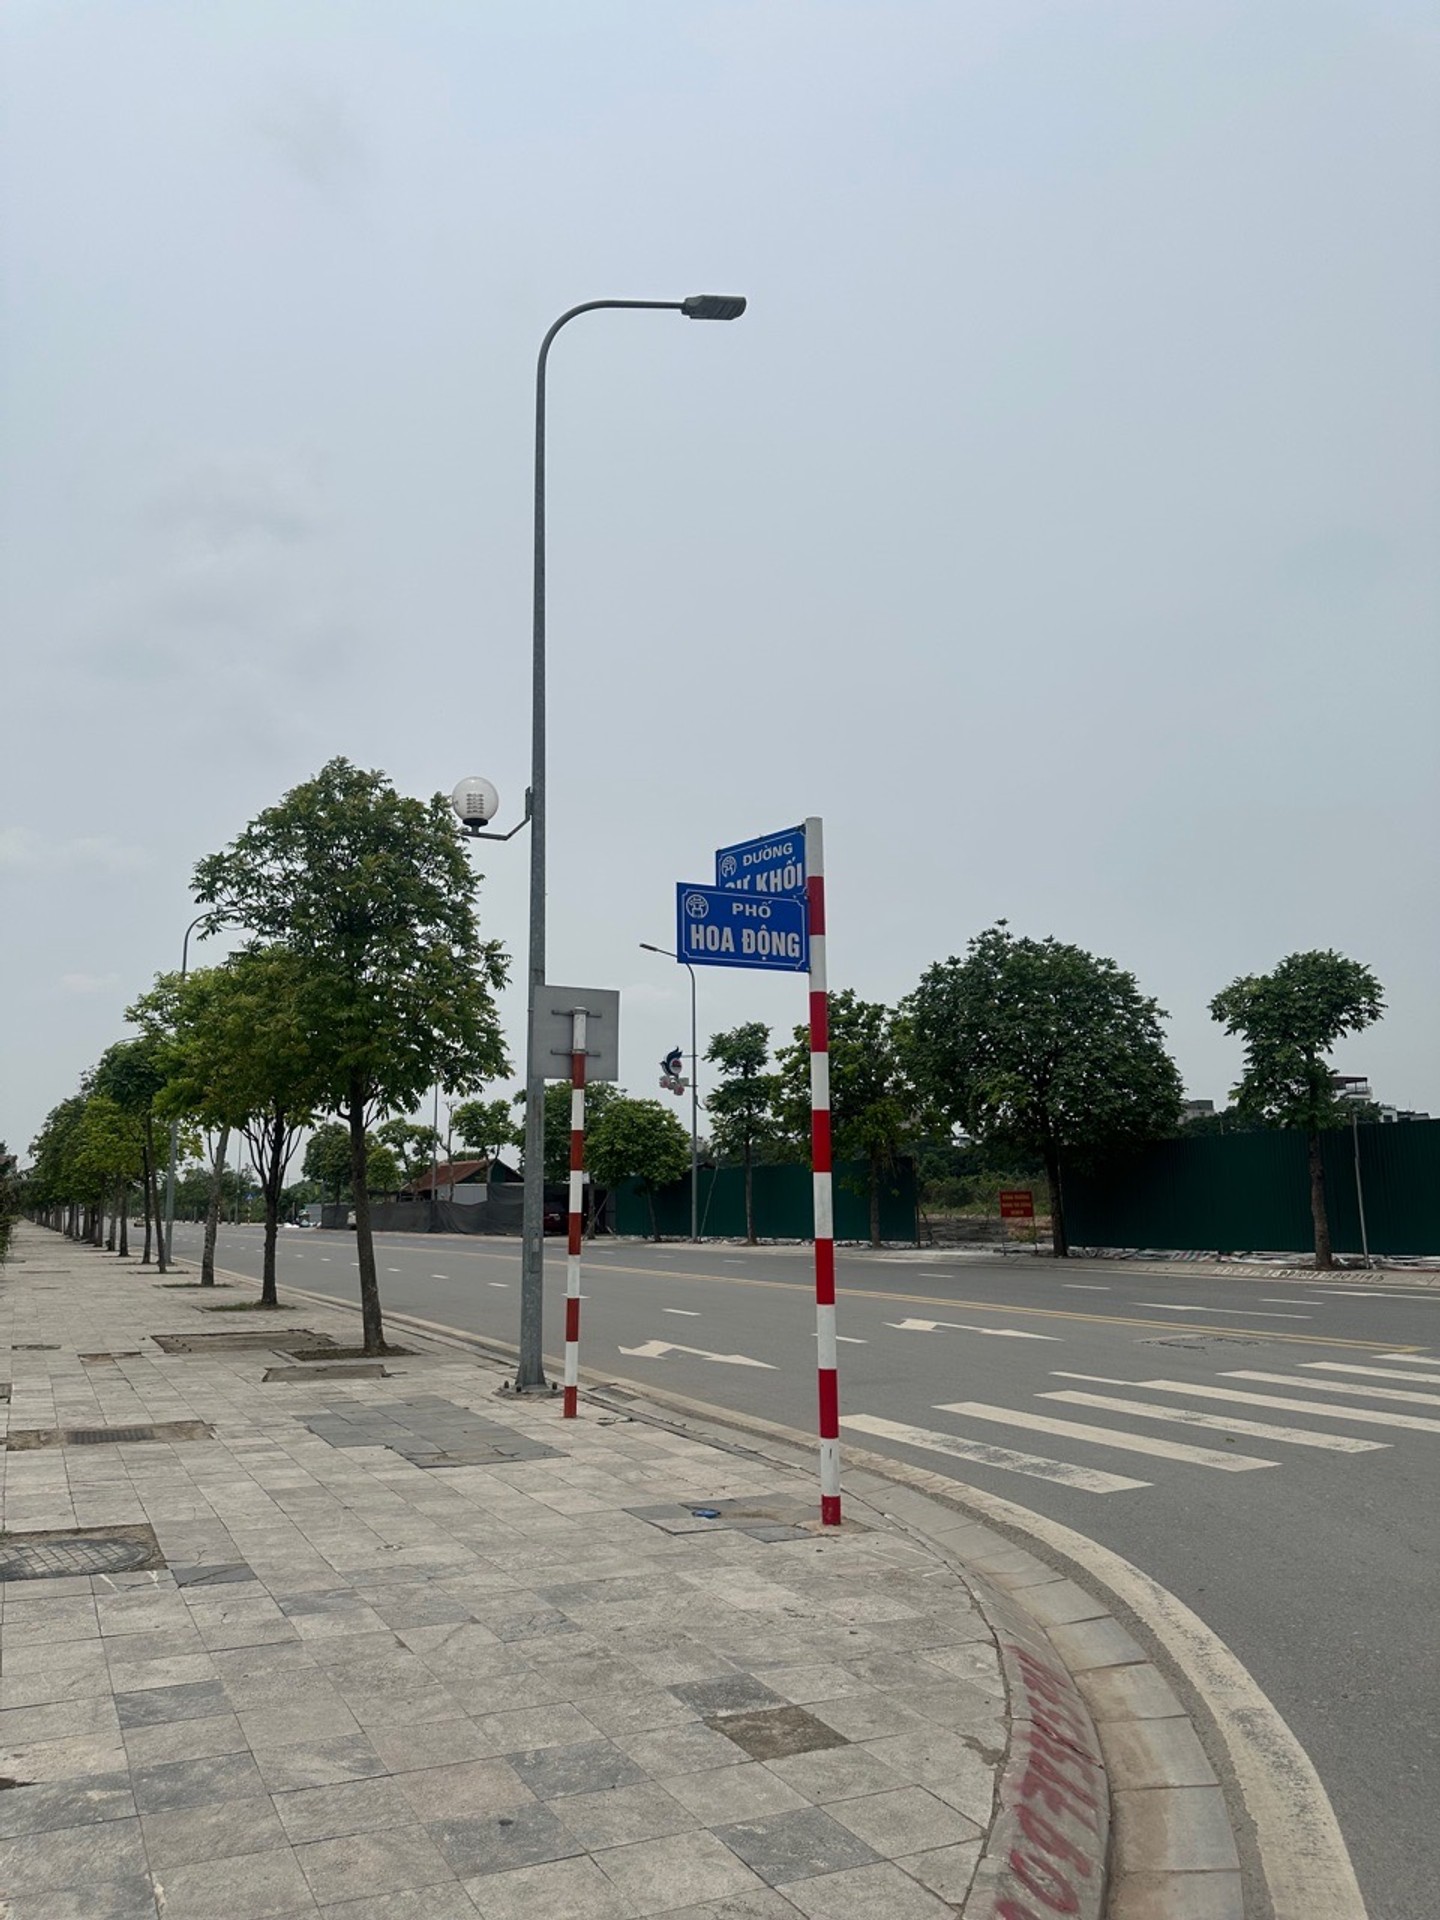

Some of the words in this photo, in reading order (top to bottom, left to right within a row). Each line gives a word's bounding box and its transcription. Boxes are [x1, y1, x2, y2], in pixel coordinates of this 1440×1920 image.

[743, 842, 793, 866] ĐƯỜNG
[756, 857, 803, 893] KHỐI
[732, 900, 772, 918] PHỐ
[690, 923, 735, 953] HOA
[742, 925, 800, 961] ĐỘNG
